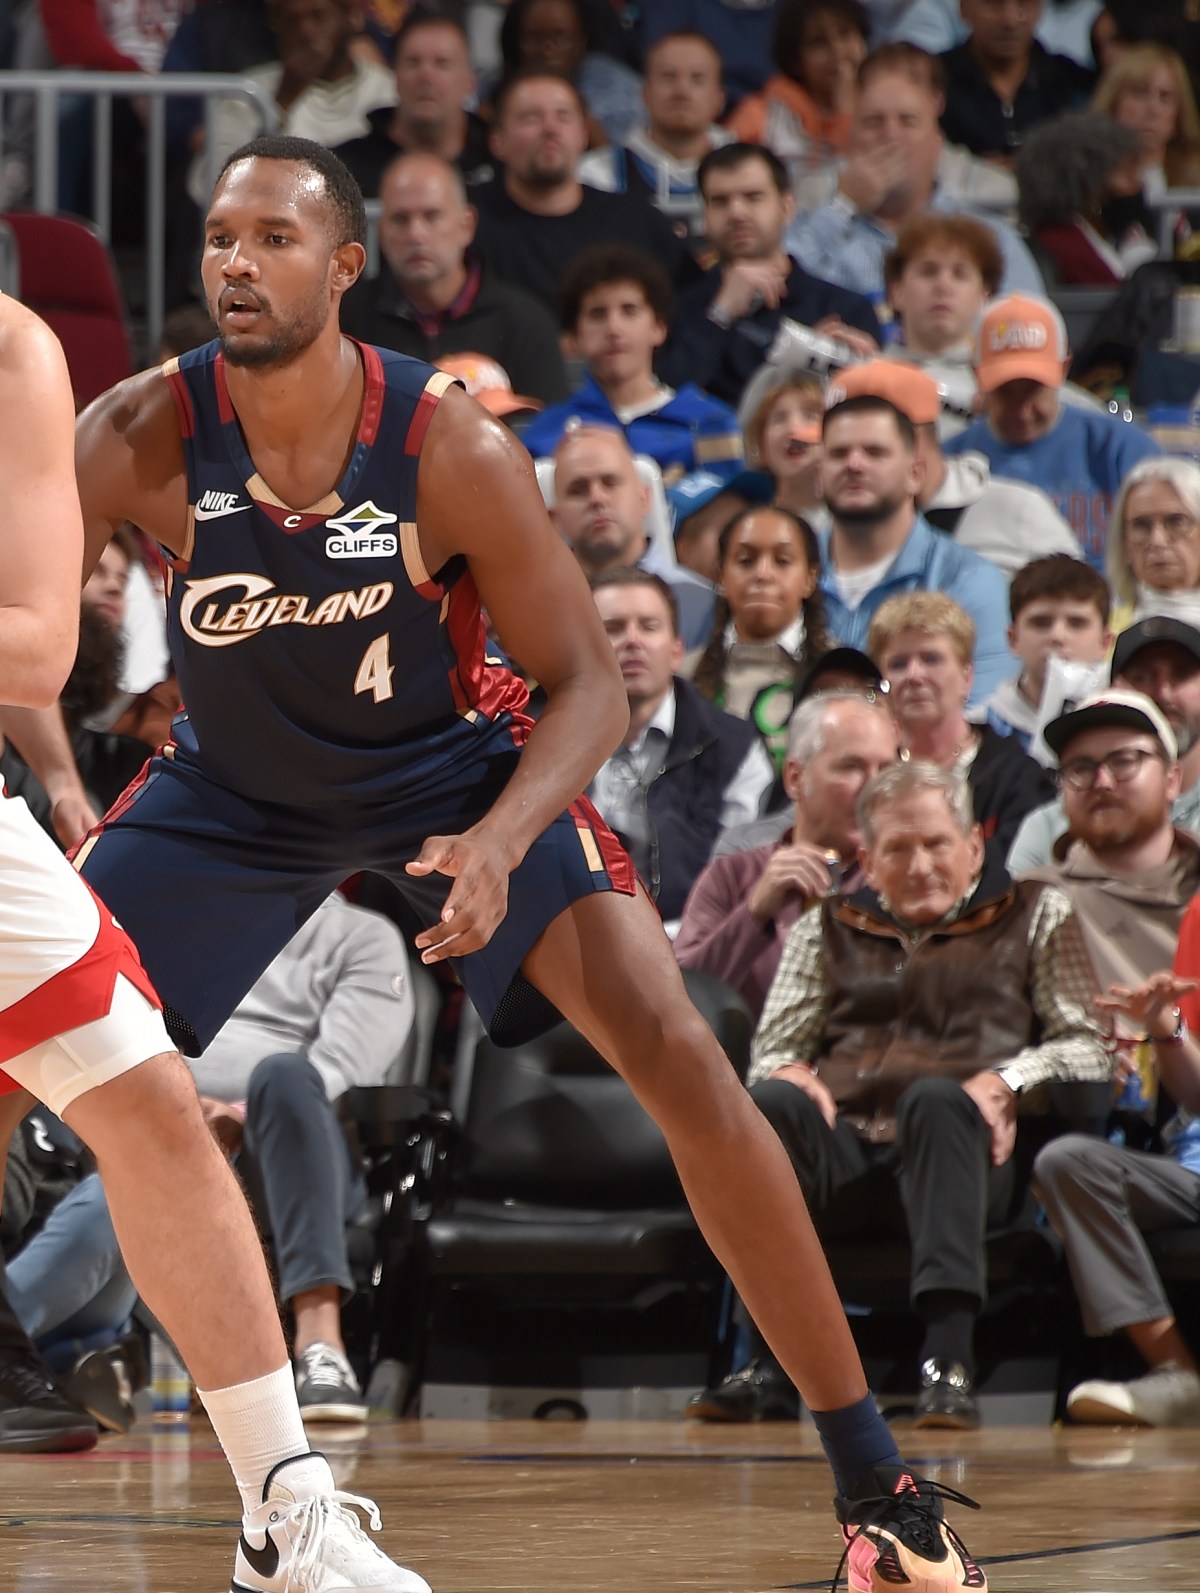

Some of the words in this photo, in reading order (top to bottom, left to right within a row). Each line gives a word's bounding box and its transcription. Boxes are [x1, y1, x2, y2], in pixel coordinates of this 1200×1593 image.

[201, 489, 239, 511] NIKE
[283, 515, 302, 528] C
[328, 538, 395, 554] CLIFFS
[180, 572, 394, 647] CLEVELAND
[354, 632, 396, 704] 4
